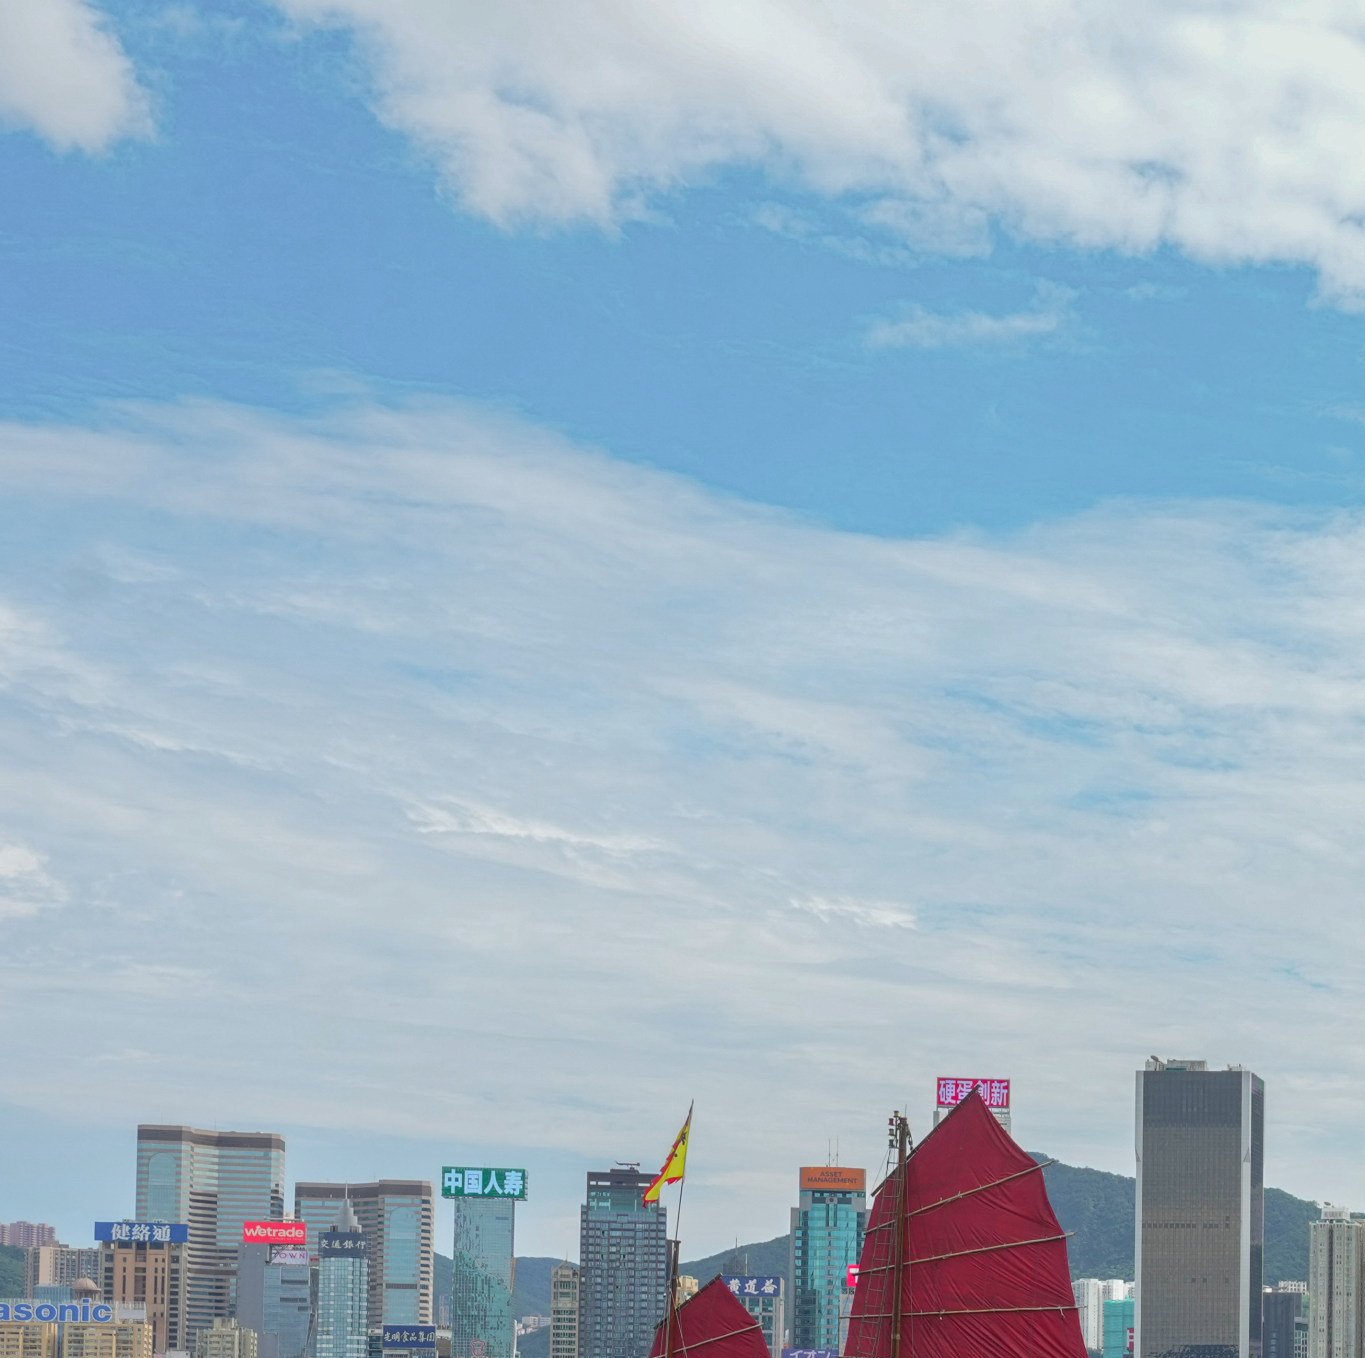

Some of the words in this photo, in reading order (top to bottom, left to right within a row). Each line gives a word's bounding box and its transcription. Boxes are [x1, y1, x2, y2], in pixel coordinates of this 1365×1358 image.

[444, 1168, 524, 1196] 中国人寿
[244, 1225, 305, 1238] wetrade
[320, 1239, 367, 1249] 交通銀行
